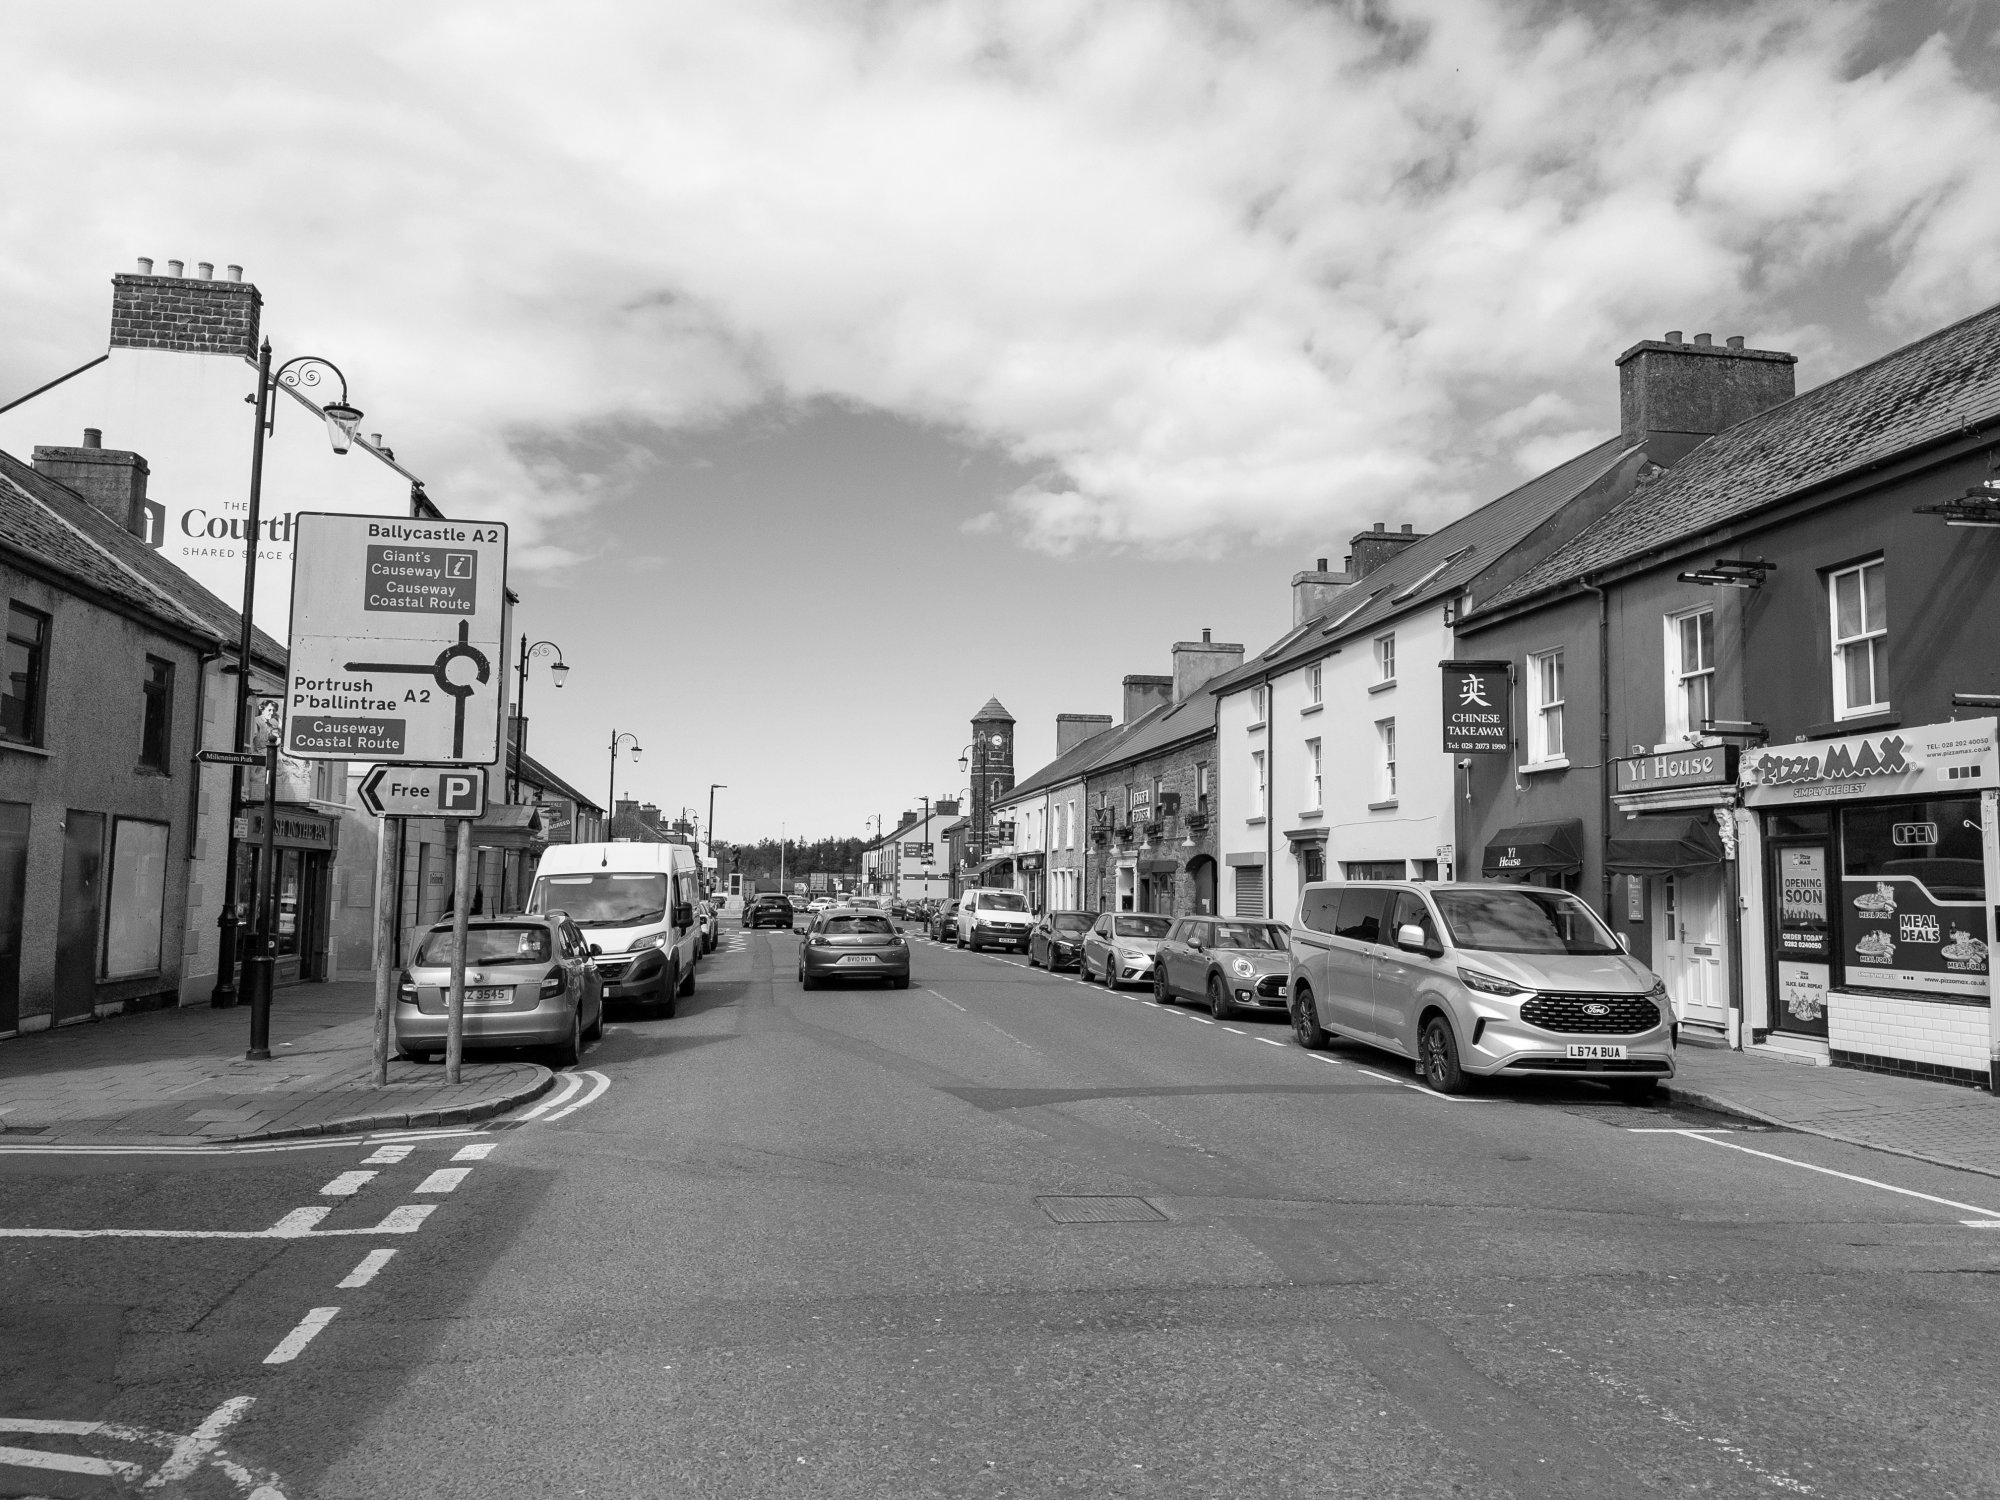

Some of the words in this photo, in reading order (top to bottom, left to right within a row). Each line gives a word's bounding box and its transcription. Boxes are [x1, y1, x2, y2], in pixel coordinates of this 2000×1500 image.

[224, 502, 248, 511] THE
[368, 524, 466, 541] Ballycastle
[472, 530, 498, 543] A2
[182, 548, 234, 558] SHARED
[242, 550, 282, 560] SACE
[383, 550, 431, 563] Giant's
[372, 564, 440, 579] Causeway
[386, 582, 456, 597] Causeway
[370, 594, 424, 608] Coastal
[430, 598, 471, 610] Route
[295, 676, 373, 692] Portrush
[293, 694, 397, 711] P'ballintrae
[404, 689, 430, 703] A2
[1452, 713, 1500, 723] CHINESE
[313, 721, 385, 736] Causeway
[1448, 726, 1505, 736] TAKEAWAY
[295, 735, 352, 748] Coastal
[358, 737, 400, 749] Route
[206, 753, 240, 762] Millennium
[1822, 735, 1905, 779] MAX
[1926, 746, 1991, 757] www.pizzamax.co.uk
[1628, 760, 1646, 781] Yi
[1654, 756, 1713, 779] House
[392, 783, 430, 797] Free
[445, 777, 471, 807] P
[1793, 787, 1823, 798] SIMPLY
[1825, 785, 1841, 795] THE
[1844, 783, 1866, 794] BEST
[1895, 825, 1936, 843] OPEN
[1499, 857, 1521, 866] House
[1785, 879, 1822, 887] OPENING
[1785, 889, 1822, 904] SOON
[1900, 915, 1939, 929] MEAL
[1901, 929, 1940, 943] DEALS
[1924, 976, 1986, 986] www.pizzamax.co.uk
[477, 990, 504, 999] 3545
[1587, 1005, 1605, 1014] Ford
[1601, 1047, 1620, 1057] BUA
